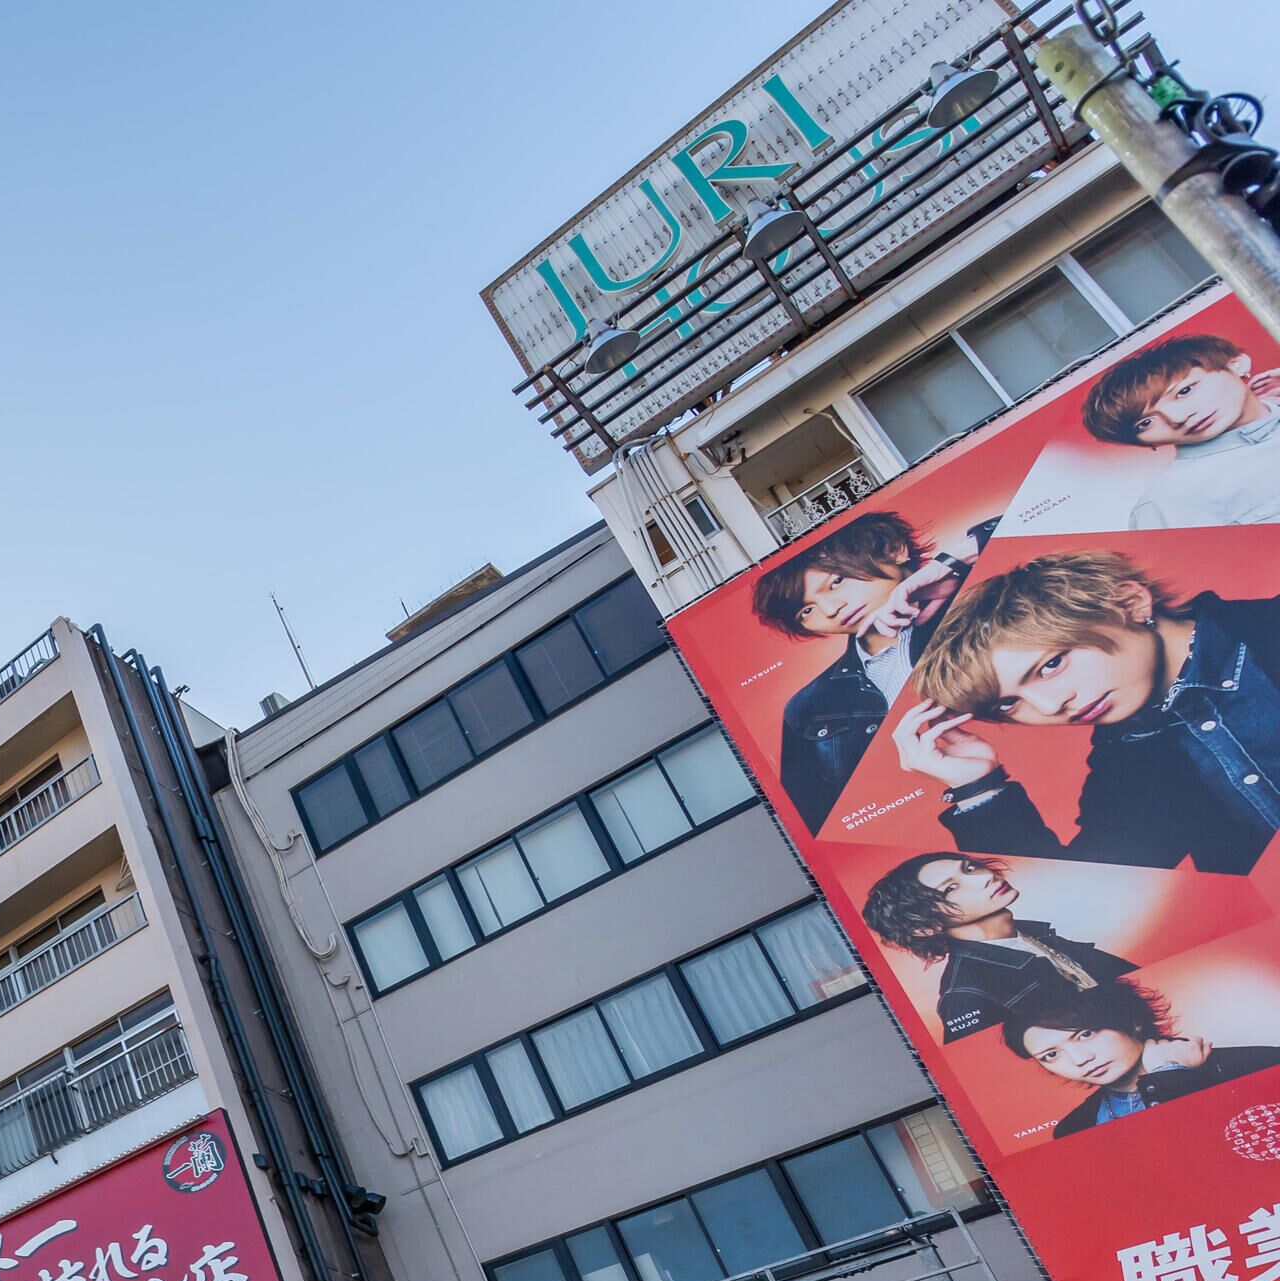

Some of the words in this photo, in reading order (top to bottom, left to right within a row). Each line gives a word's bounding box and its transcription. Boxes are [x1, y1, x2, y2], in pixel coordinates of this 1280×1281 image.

[528, 73, 837, 352] JURI
[1018, 498, 1053, 520] TAMIO
[1022, 494, 1072, 525] AKEGAMI
[740, 660, 784, 687] NATSUME
[840, 802, 877, 824] GAKU
[845, 788, 926, 832] SHINONOME
[946, 1008, 982, 1027] SHION
[949, 1017, 981, 1034] KUJO
[1013, 1119, 1060, 1139] YAMATO
[166, 1133, 225, 1179] 一蘭
